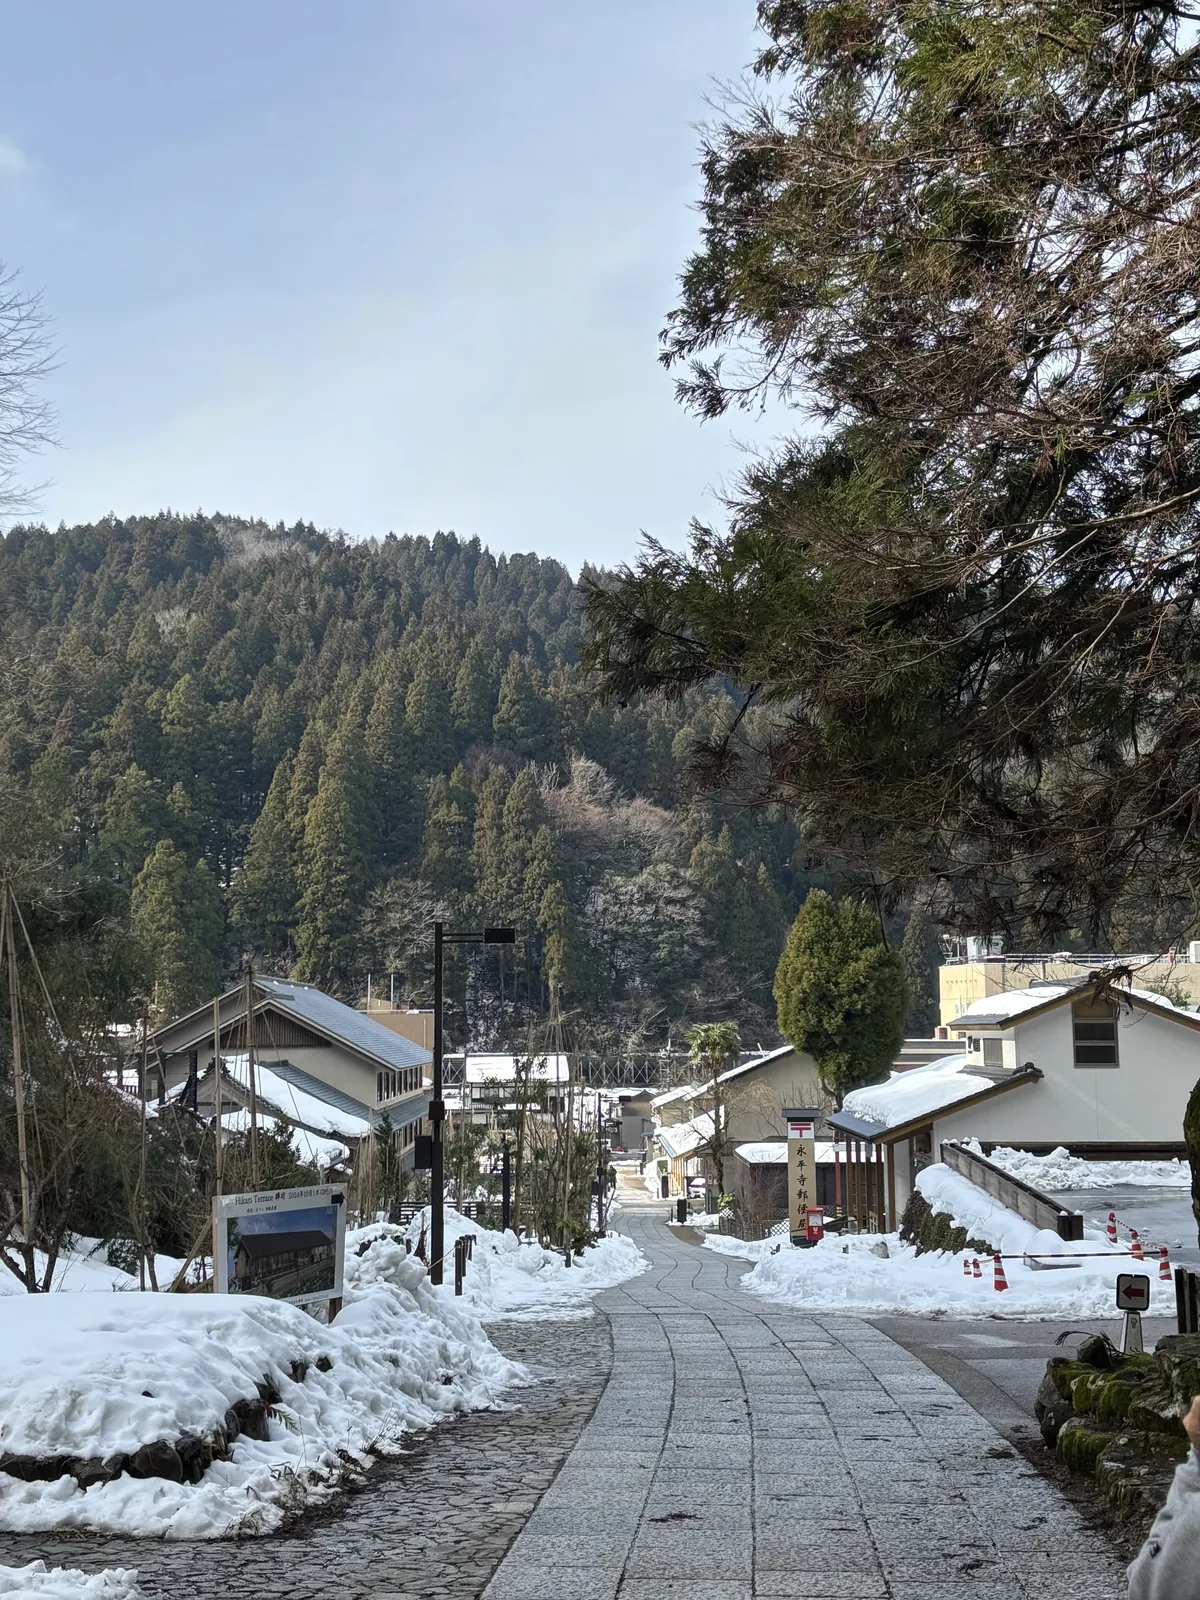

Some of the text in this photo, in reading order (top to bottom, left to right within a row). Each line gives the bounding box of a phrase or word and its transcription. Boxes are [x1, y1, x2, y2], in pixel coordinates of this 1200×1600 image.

[253, 1194, 273, 1203] Terrace
[796, 1144, 808, 1229] 永平寺郵便局
